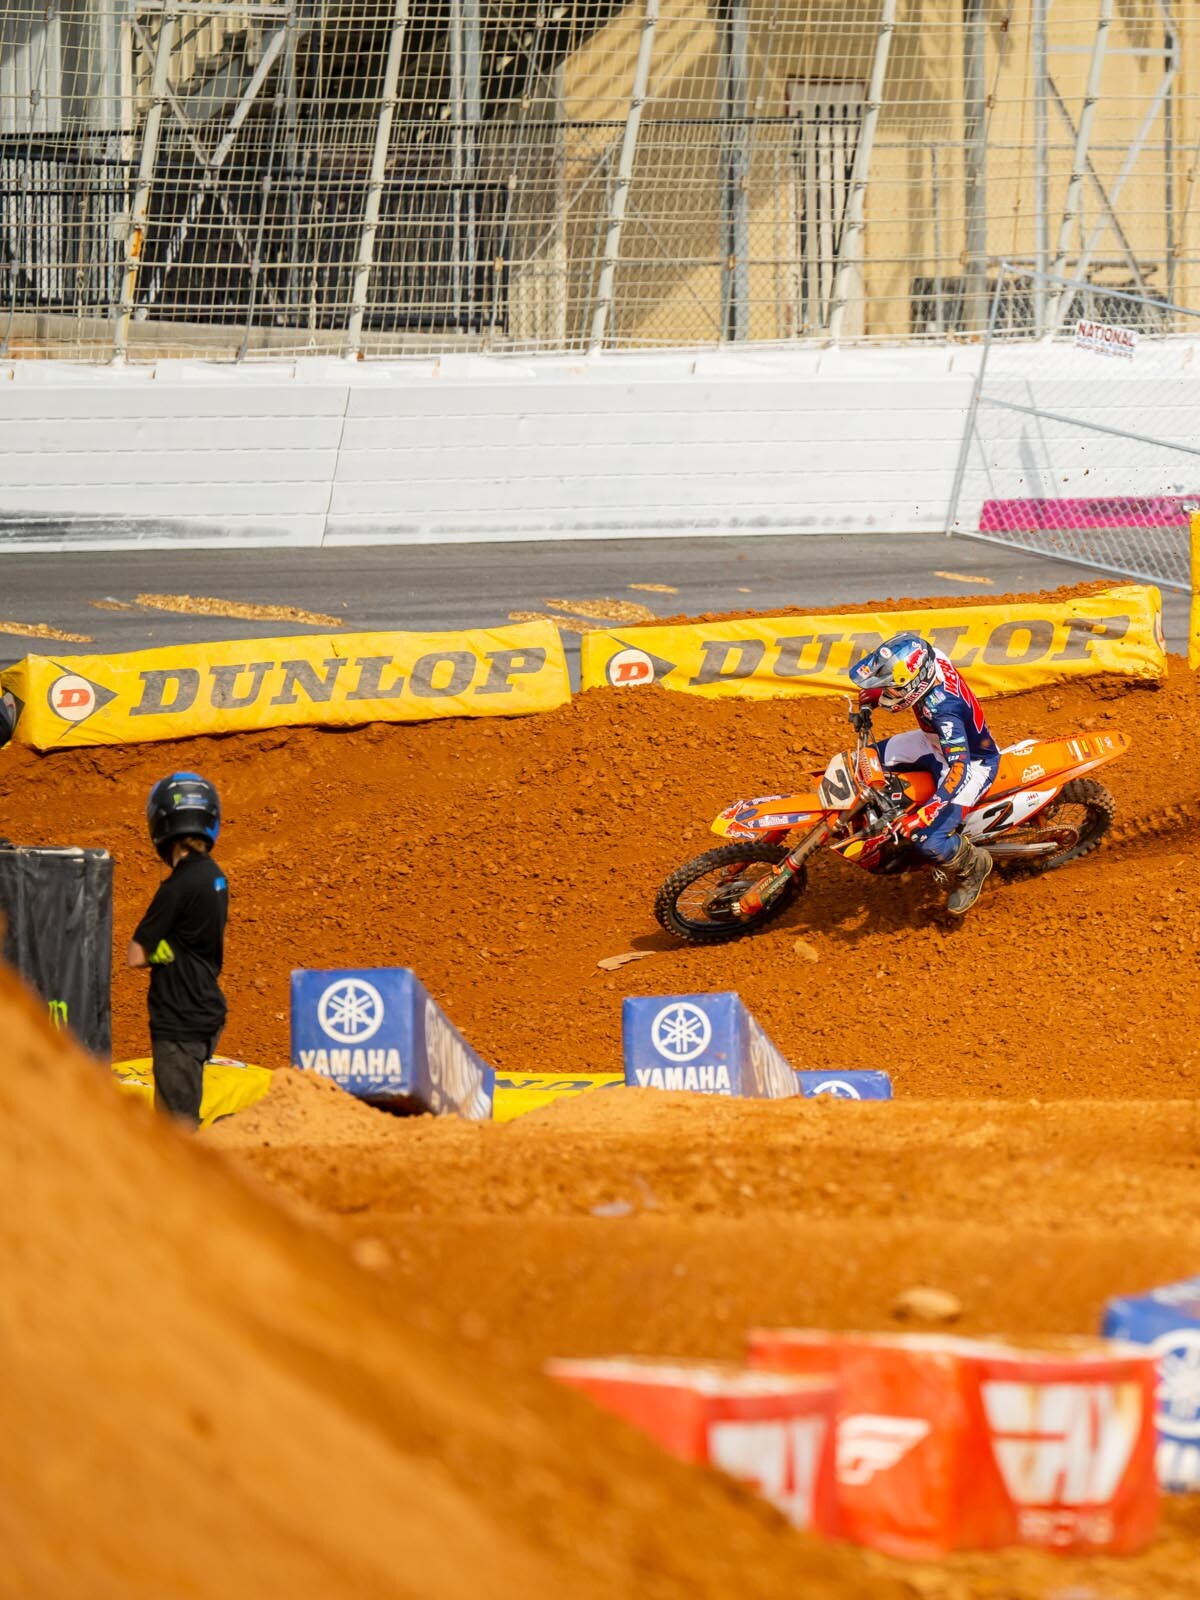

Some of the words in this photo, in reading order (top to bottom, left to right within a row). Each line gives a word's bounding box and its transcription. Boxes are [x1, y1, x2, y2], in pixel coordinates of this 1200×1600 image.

[1079, 322, 1135, 347] NATIONAL
[129, 646, 547, 717] DUNLOP
[821, 769, 851, 806] 2
[982, 800, 1014, 833] 2
[299, 1048, 402, 1076] YAMAHA
[635, 1065, 731, 1091] YAMAHA
